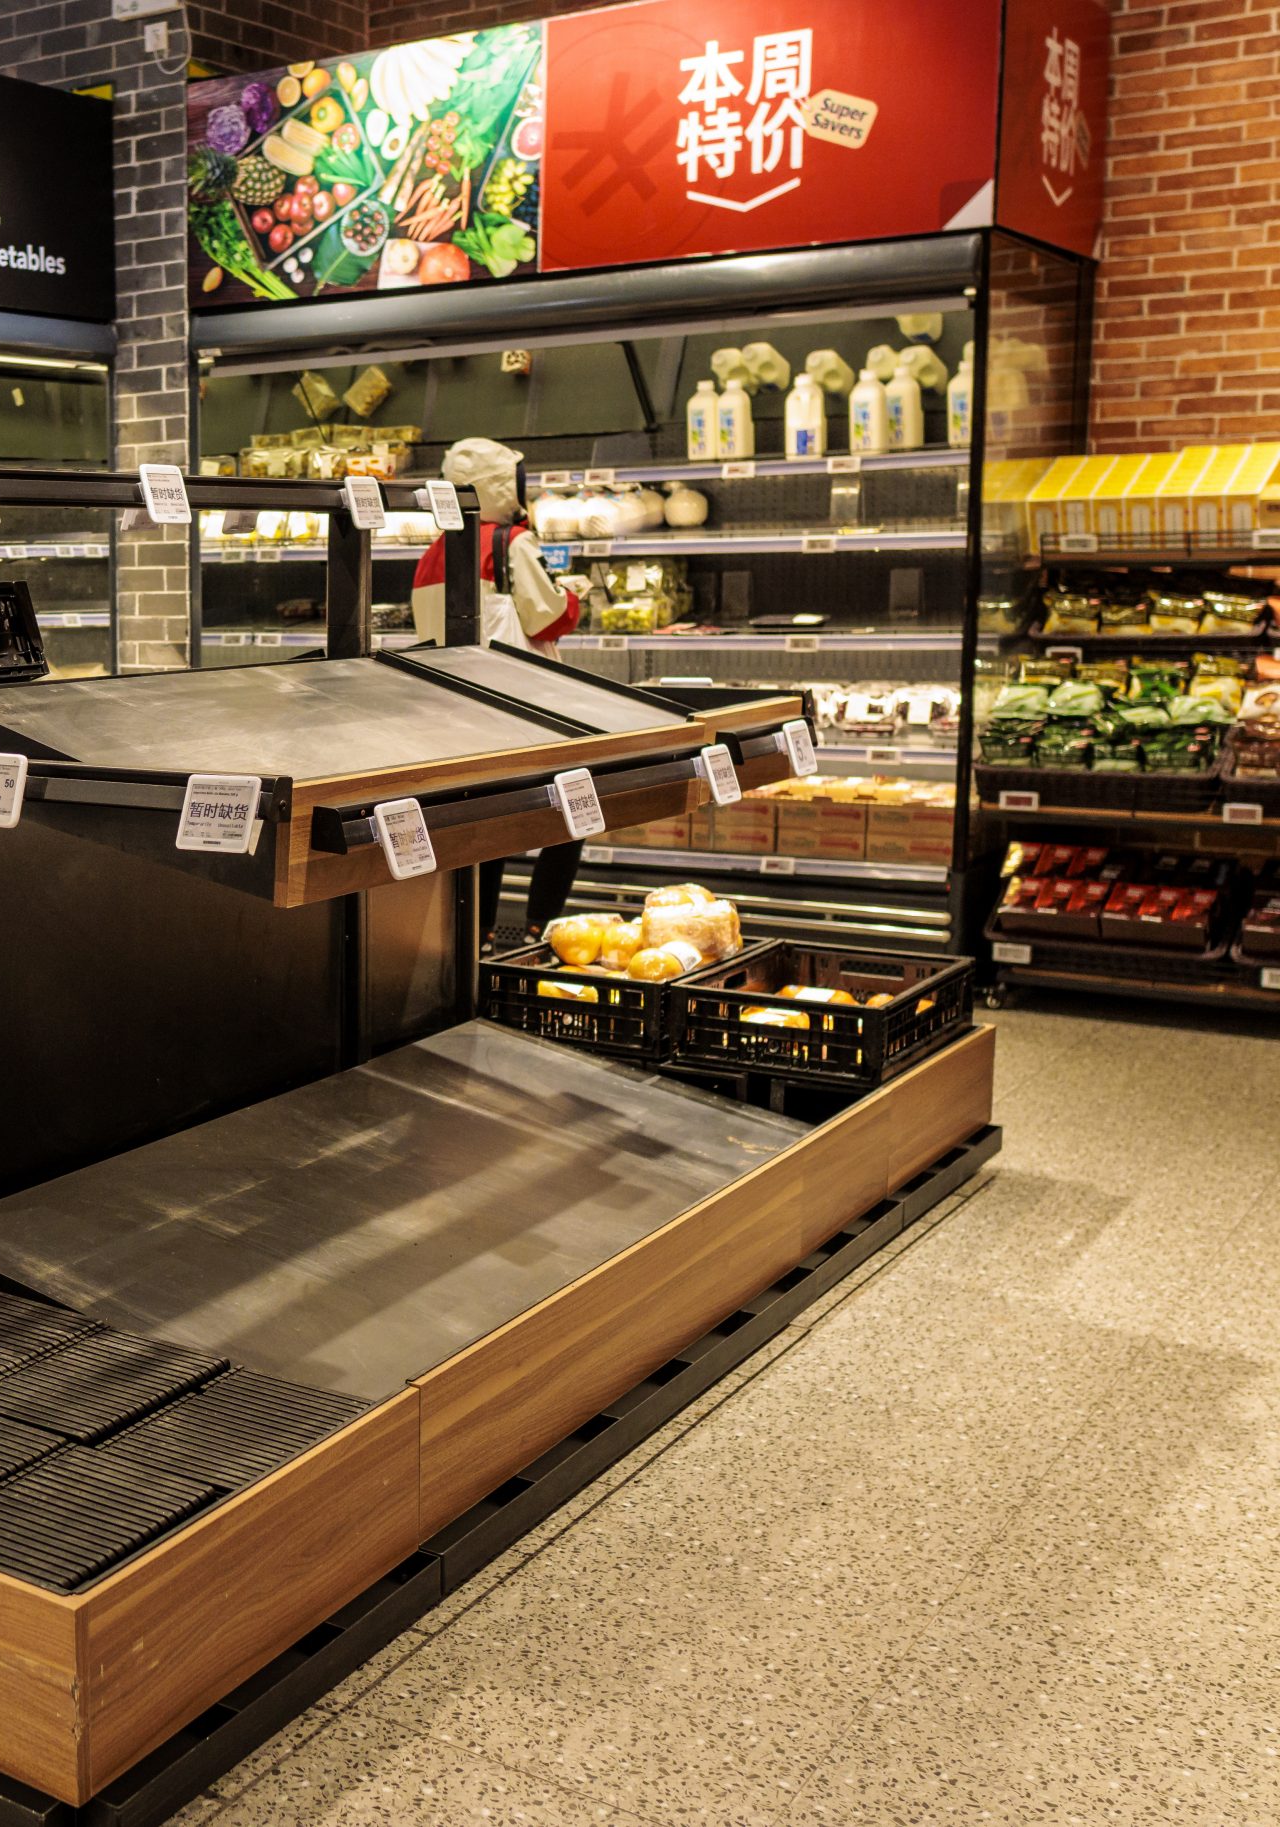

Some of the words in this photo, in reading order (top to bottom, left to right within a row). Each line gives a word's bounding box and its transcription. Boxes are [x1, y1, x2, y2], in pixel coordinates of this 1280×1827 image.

[677, 28, 813, 113] 本周
[820, 97, 869, 122] Super
[811, 113, 864, 140] Savers
[676, 98, 808, 183] 特价
[4, 778, 15, 789] 50
[189, 801, 249, 821] 暂时缺货
[567, 793, 598, 813] 暂时缺货
